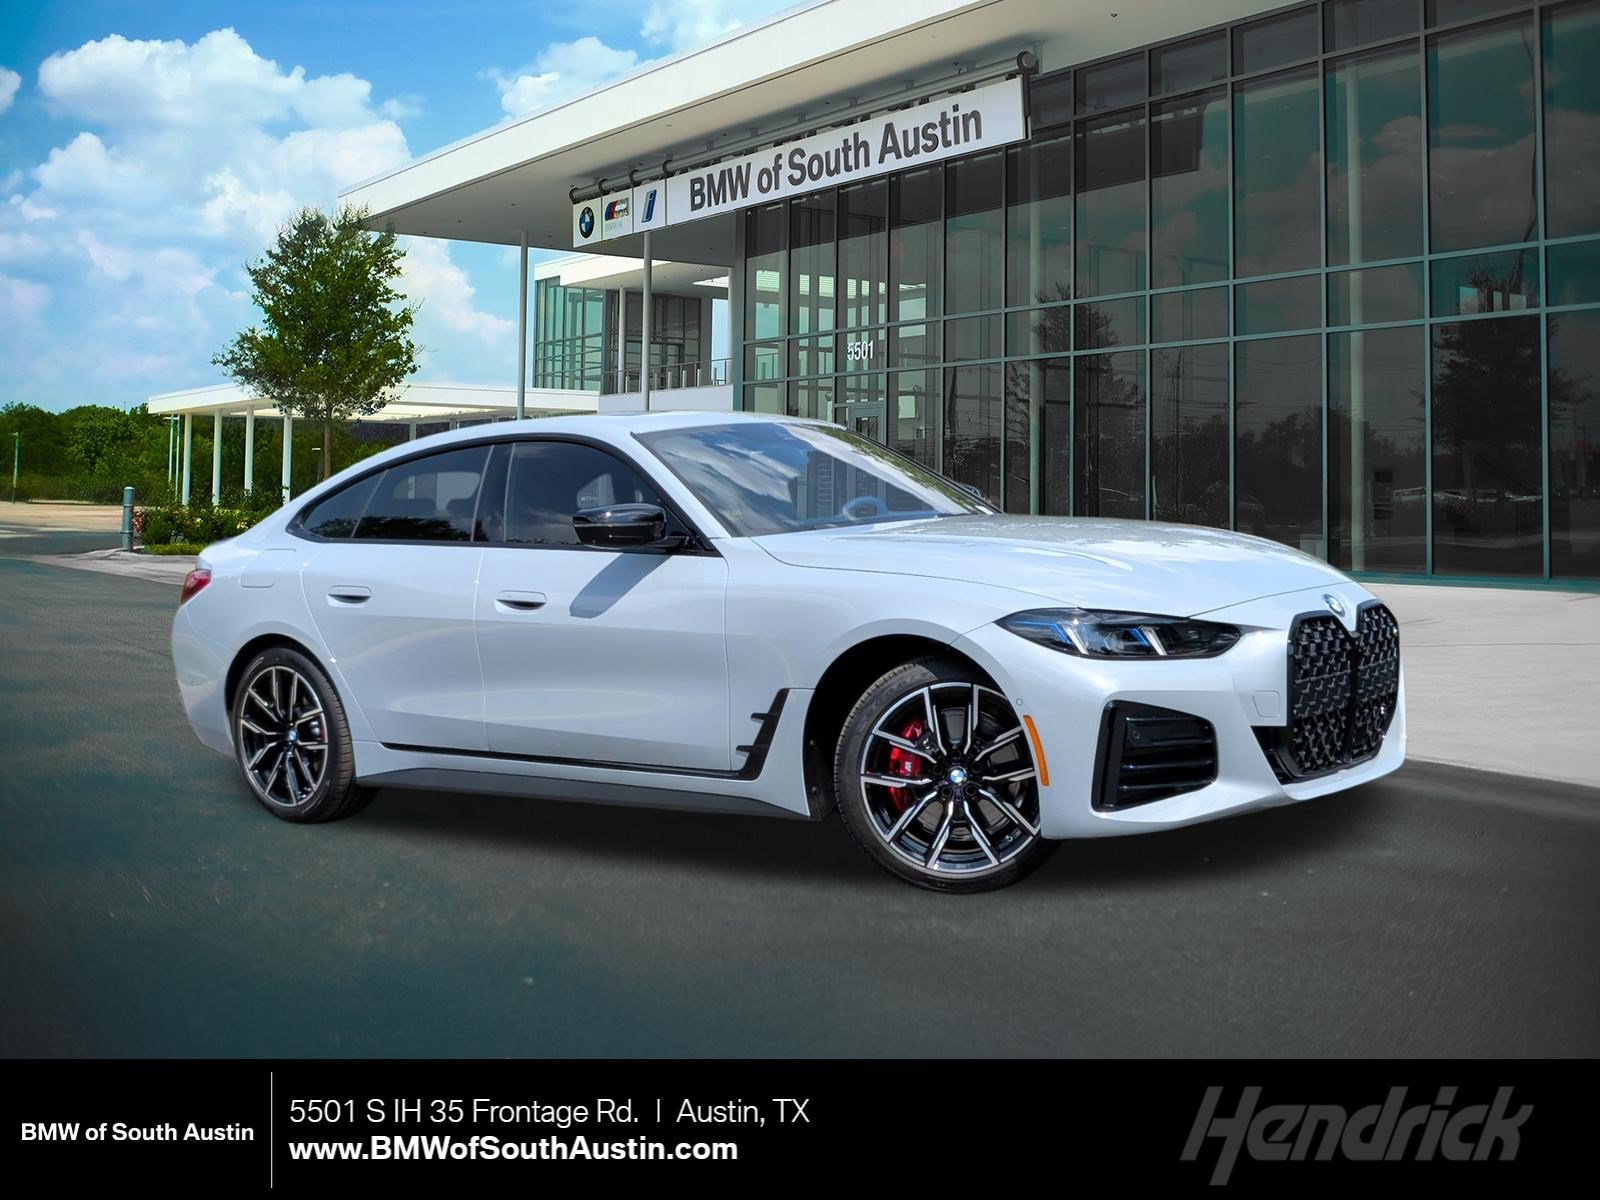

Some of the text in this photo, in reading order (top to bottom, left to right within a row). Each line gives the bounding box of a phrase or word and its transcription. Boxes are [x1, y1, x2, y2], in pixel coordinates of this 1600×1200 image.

[690, 104, 983, 212] BMW of South Austin
[847, 339, 874, 361] 5501
